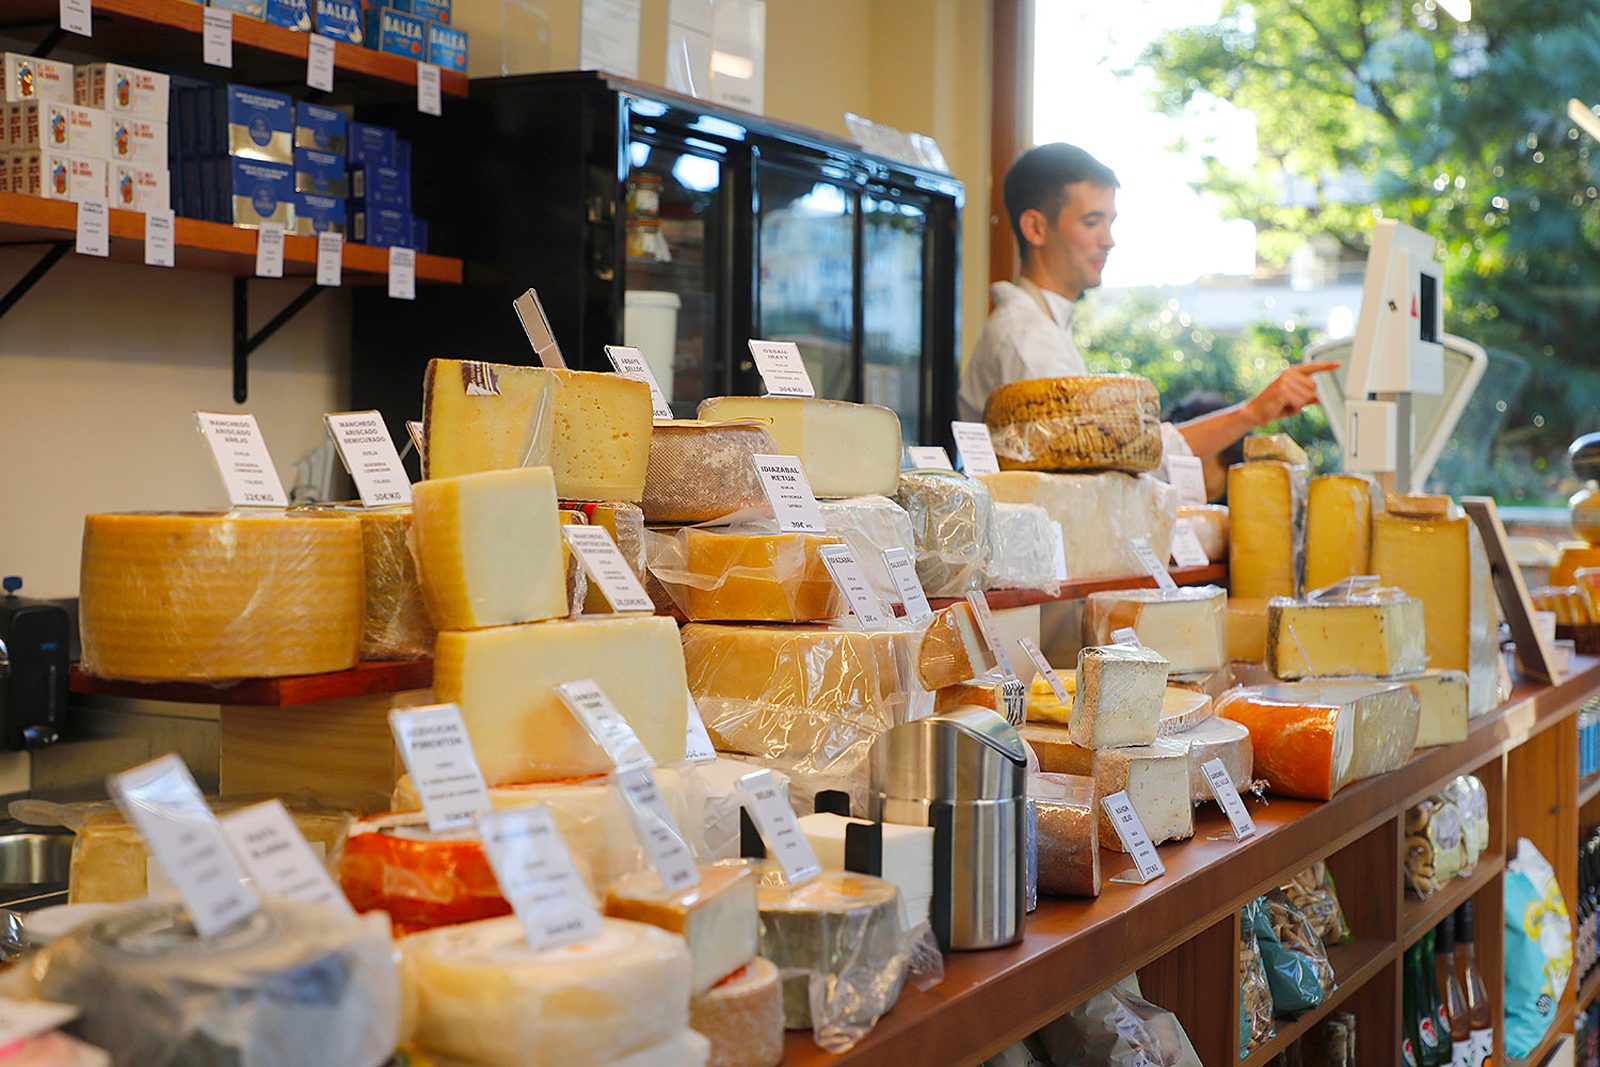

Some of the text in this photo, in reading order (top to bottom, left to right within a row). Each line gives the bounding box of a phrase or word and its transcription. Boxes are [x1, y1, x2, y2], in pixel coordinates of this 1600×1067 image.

[317, 0, 358, 22] BALEA
[383, 15, 423, 38] BALEA
[209, 420, 250, 428] MANCHEGO
[339, 420, 377, 428] MANCHEGO
[343, 436, 386, 444] SEMICURADO
[760, 465, 799, 474] IDIAZABAL
